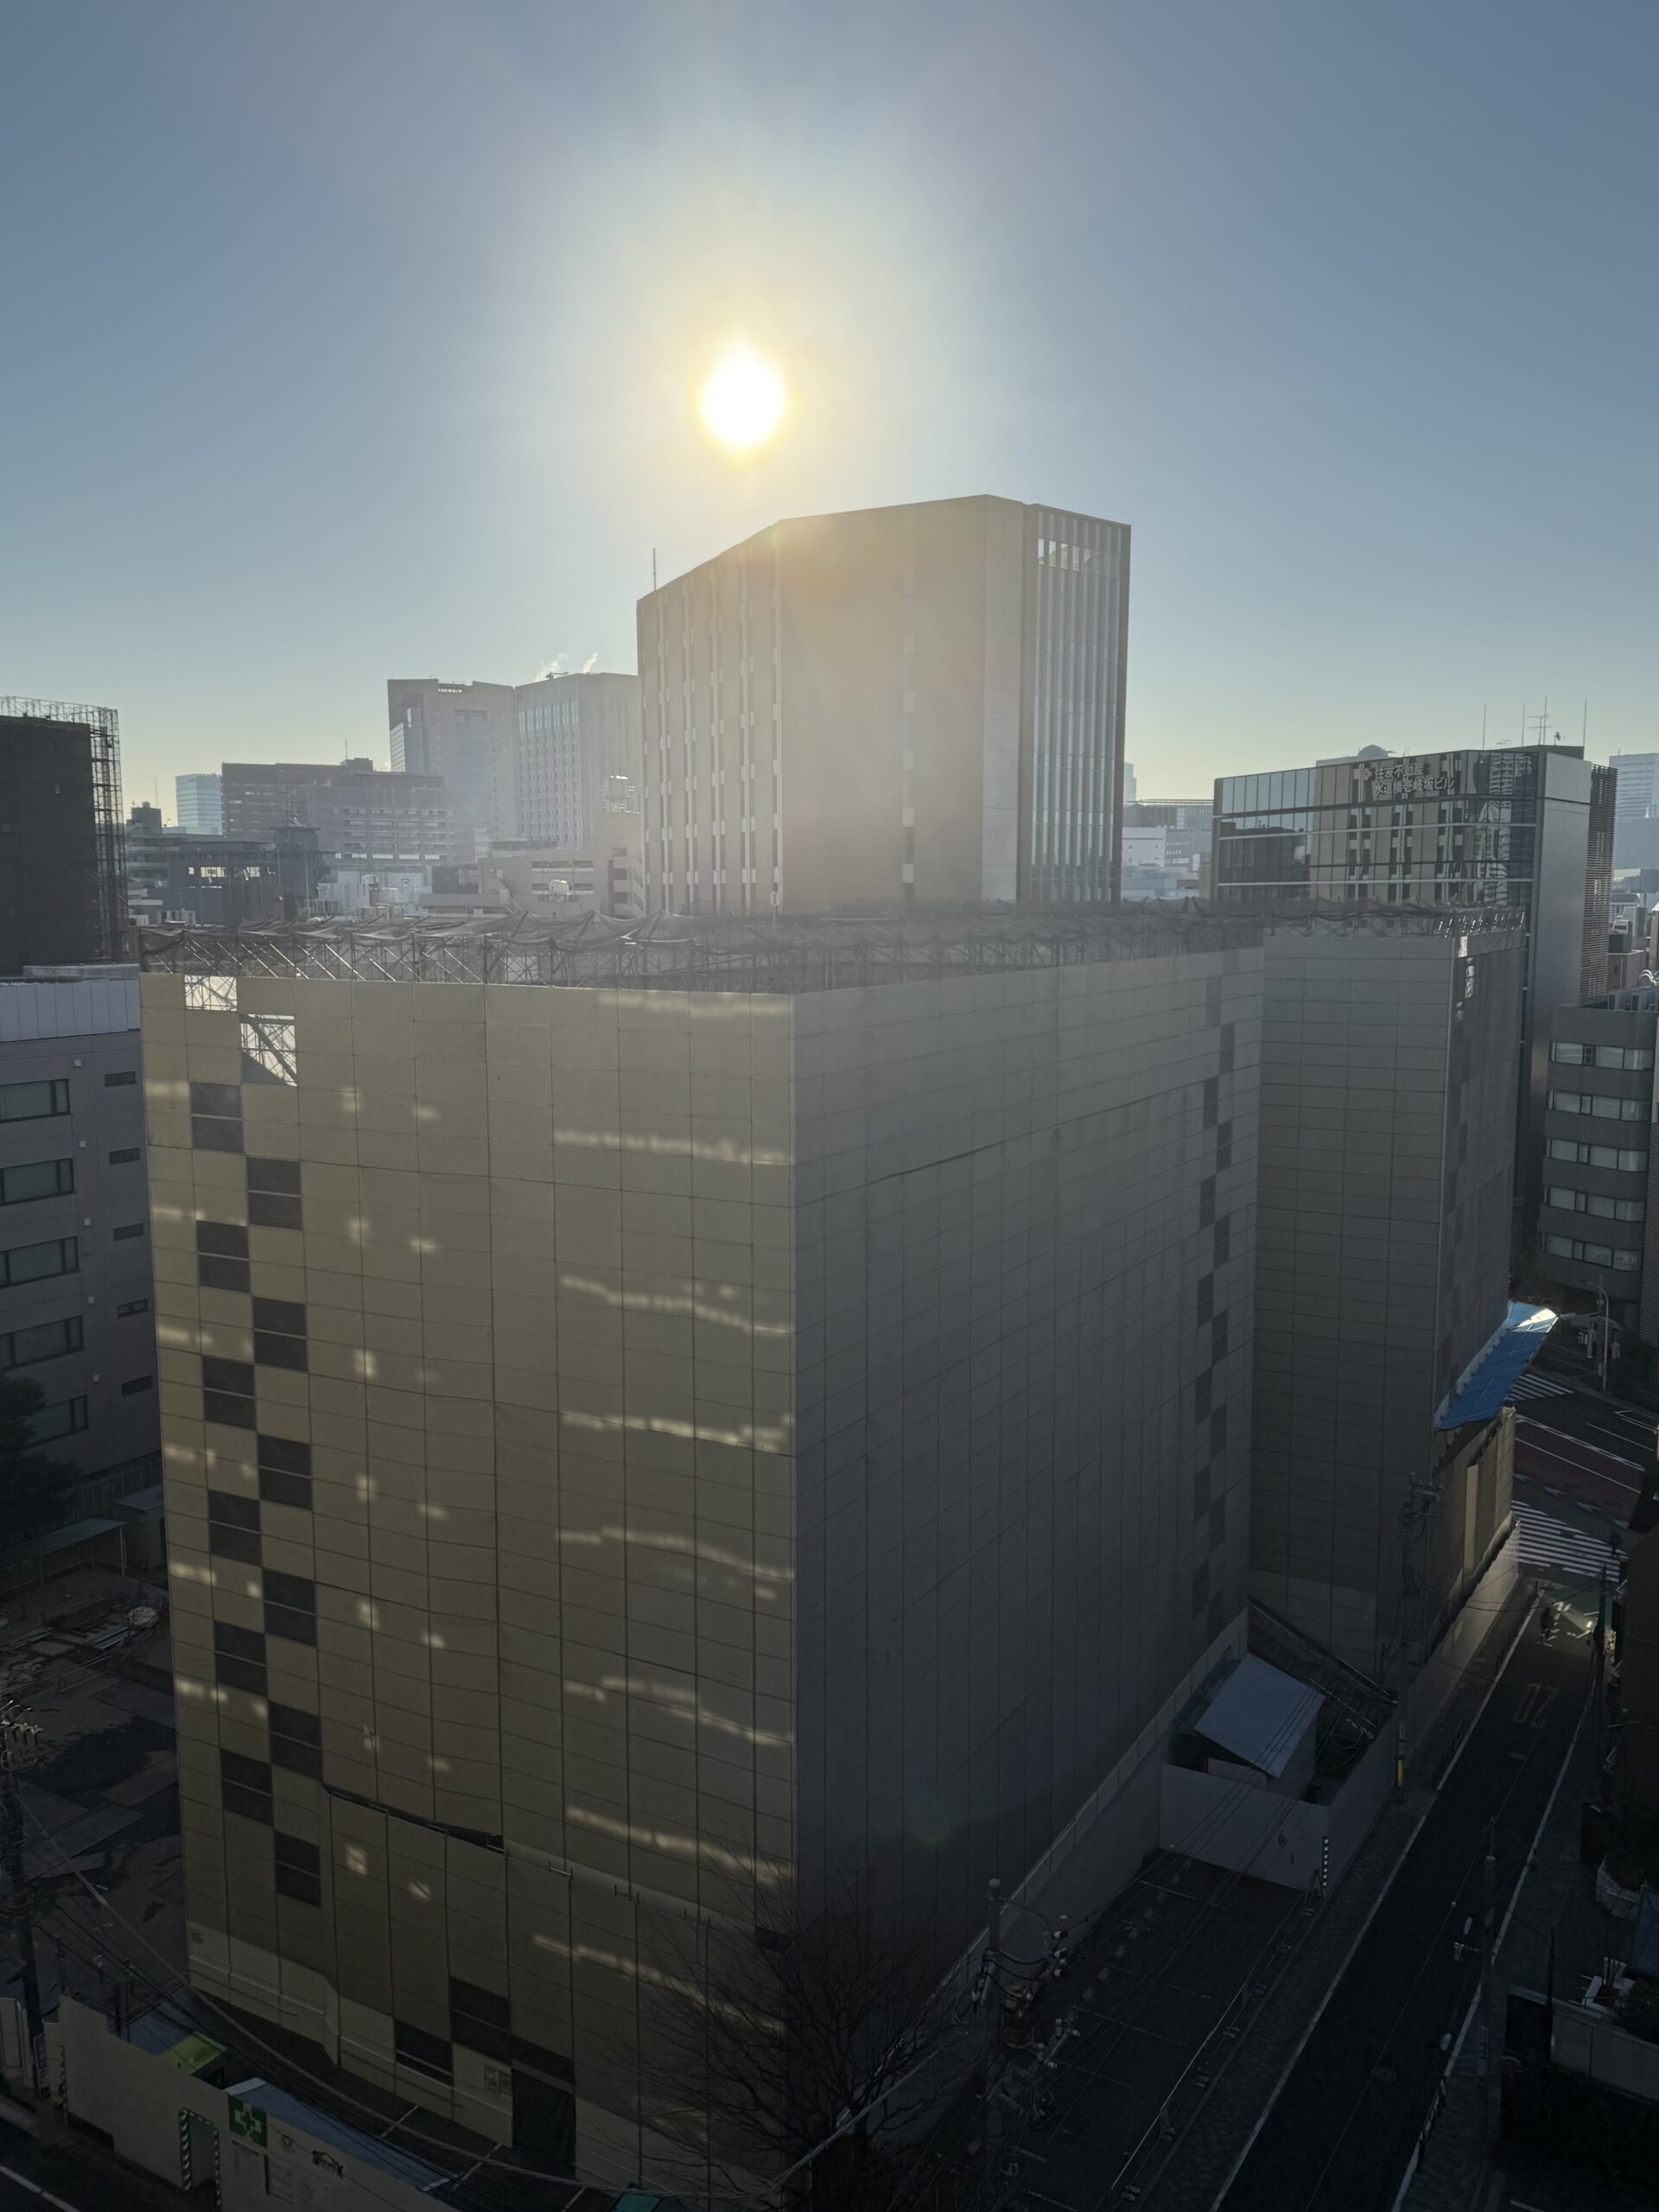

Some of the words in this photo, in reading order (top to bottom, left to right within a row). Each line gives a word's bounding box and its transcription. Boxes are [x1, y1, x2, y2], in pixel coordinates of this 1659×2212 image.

[1375, 763, 1425, 779] 住友不動産
